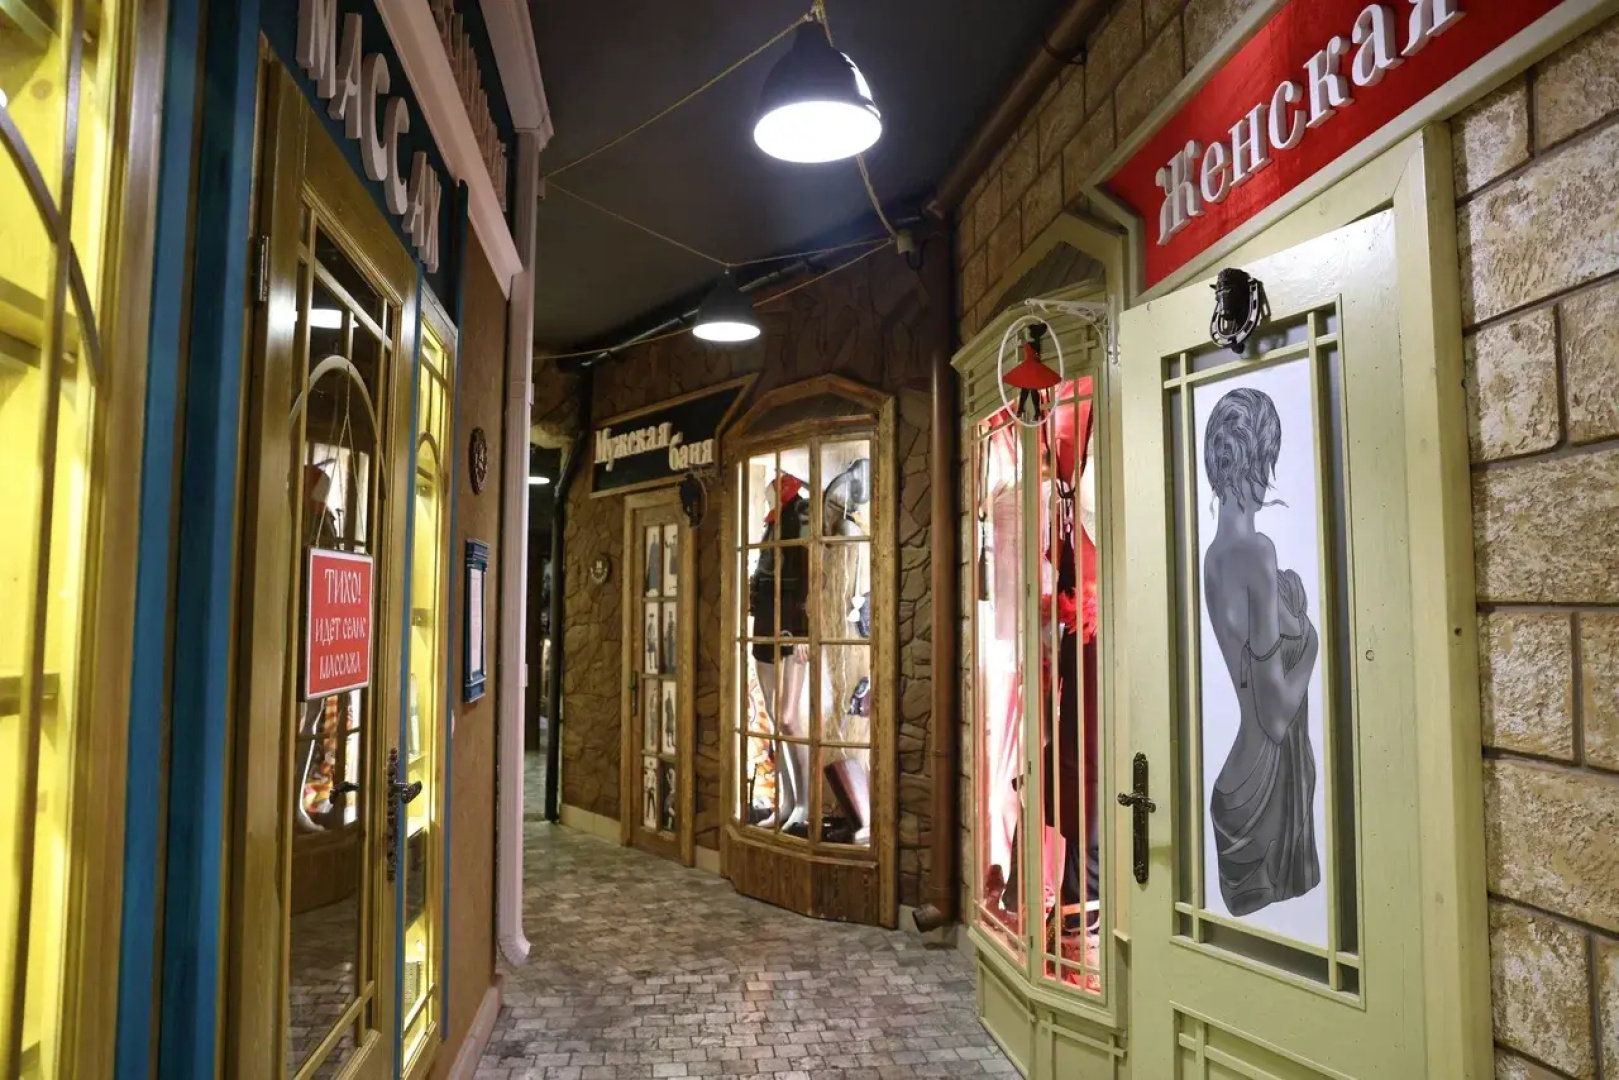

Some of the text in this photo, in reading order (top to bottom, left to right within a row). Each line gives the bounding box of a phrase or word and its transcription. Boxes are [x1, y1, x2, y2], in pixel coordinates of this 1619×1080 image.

[593, 421, 716, 473] Мужская баня
[324, 568, 362, 604] ТИХО!
